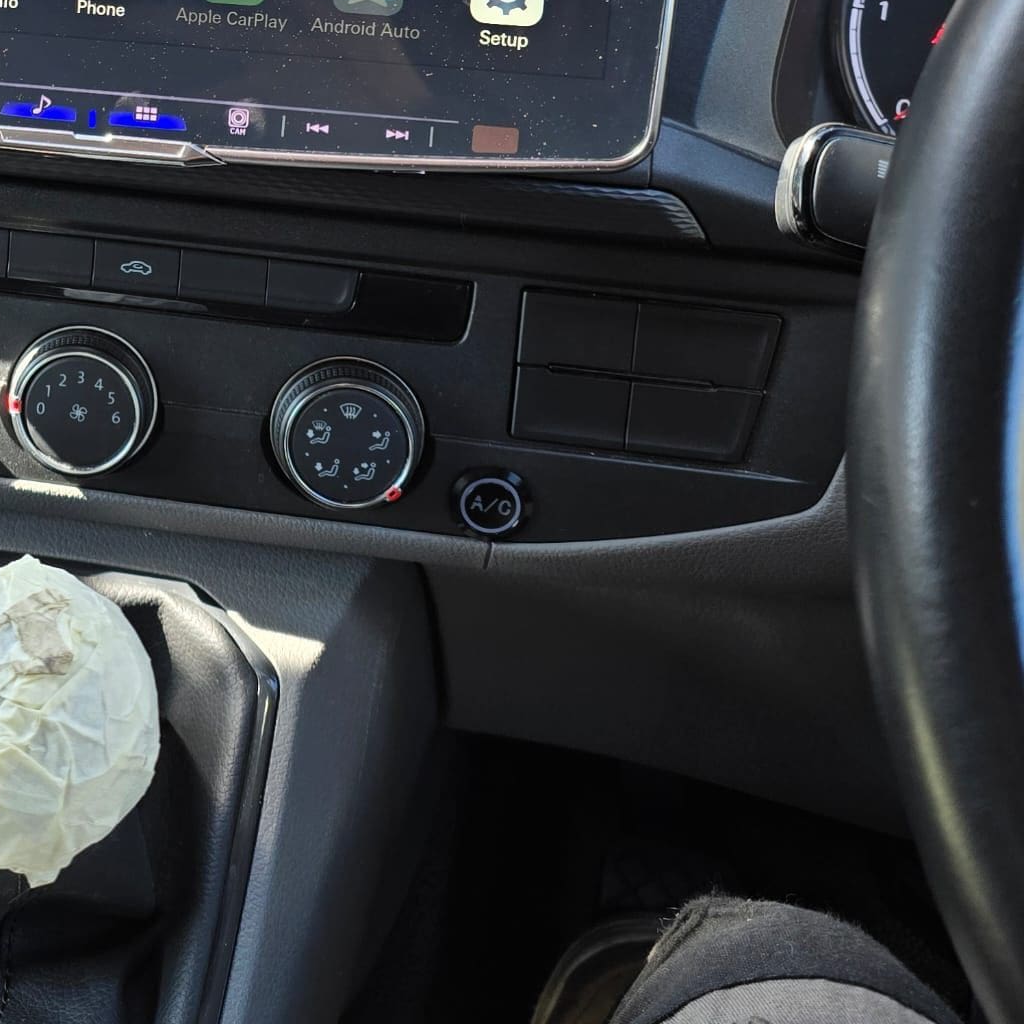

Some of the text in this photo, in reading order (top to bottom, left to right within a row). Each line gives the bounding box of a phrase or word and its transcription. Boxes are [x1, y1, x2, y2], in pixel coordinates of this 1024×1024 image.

[76, 0, 126, 17] Phone
[878, 0, 889, 21] 1
[176, 6, 288, 33] Apple CarPlay
[311, 16, 421, 40] Android Auto
[478, 29, 529, 51] Setup
[228, 126, 247, 137] CAM
[58, 373, 68, 387] 2
[76, 371, 85, 384] 3
[94, 378, 104, 391] 4
[45, 384, 51, 397] 1
[107, 391, 116, 405] 5
[36, 402, 46, 415] 0
[111, 411, 121, 425] 6
[470, 495, 512, 516] A/C
